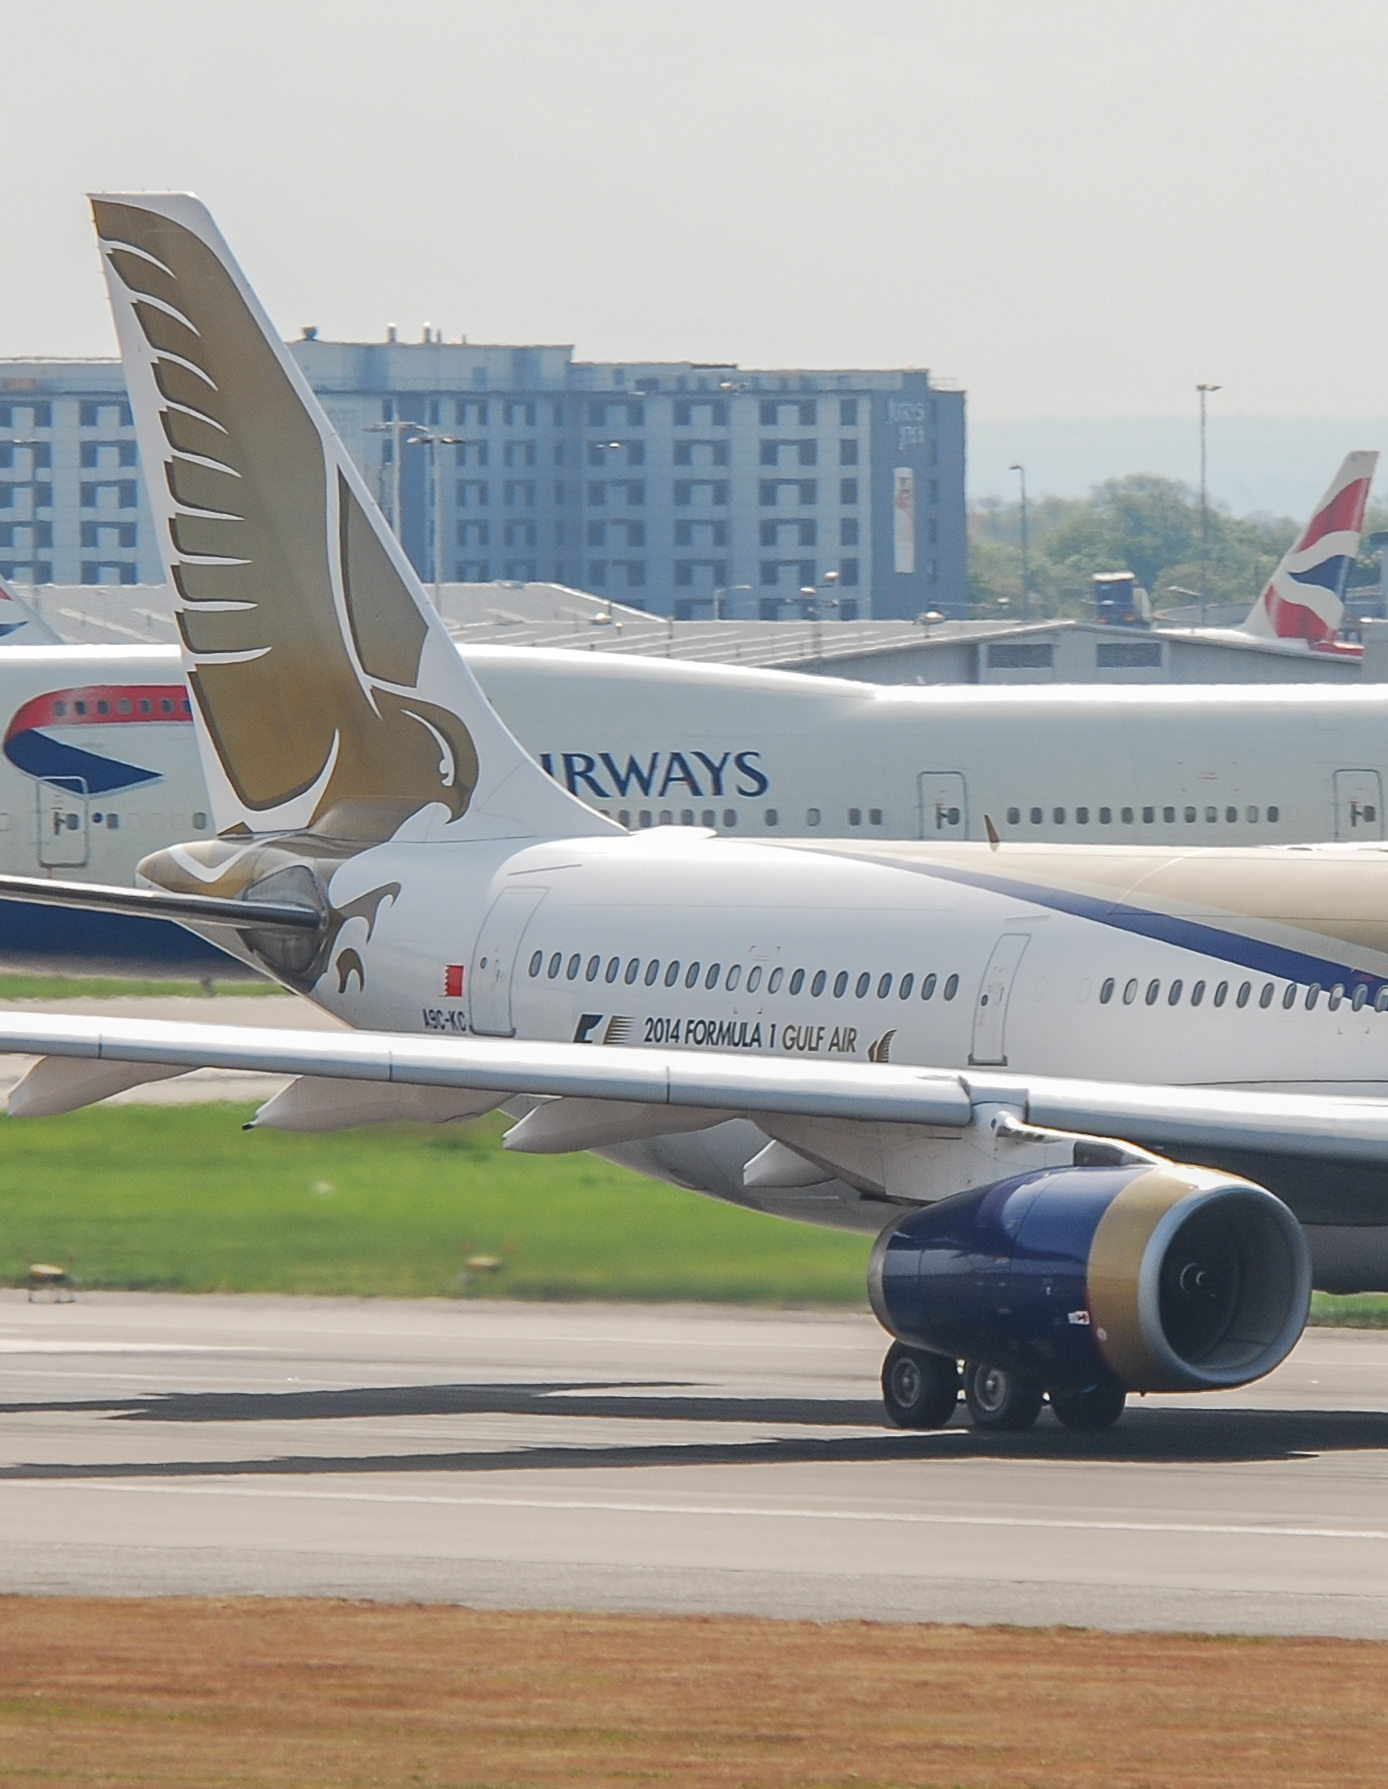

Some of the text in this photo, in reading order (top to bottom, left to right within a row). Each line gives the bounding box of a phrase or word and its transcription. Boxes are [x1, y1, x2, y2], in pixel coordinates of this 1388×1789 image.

[644, 1017, 857, 1054] 2014 FORMULA 1 GULF AIR
